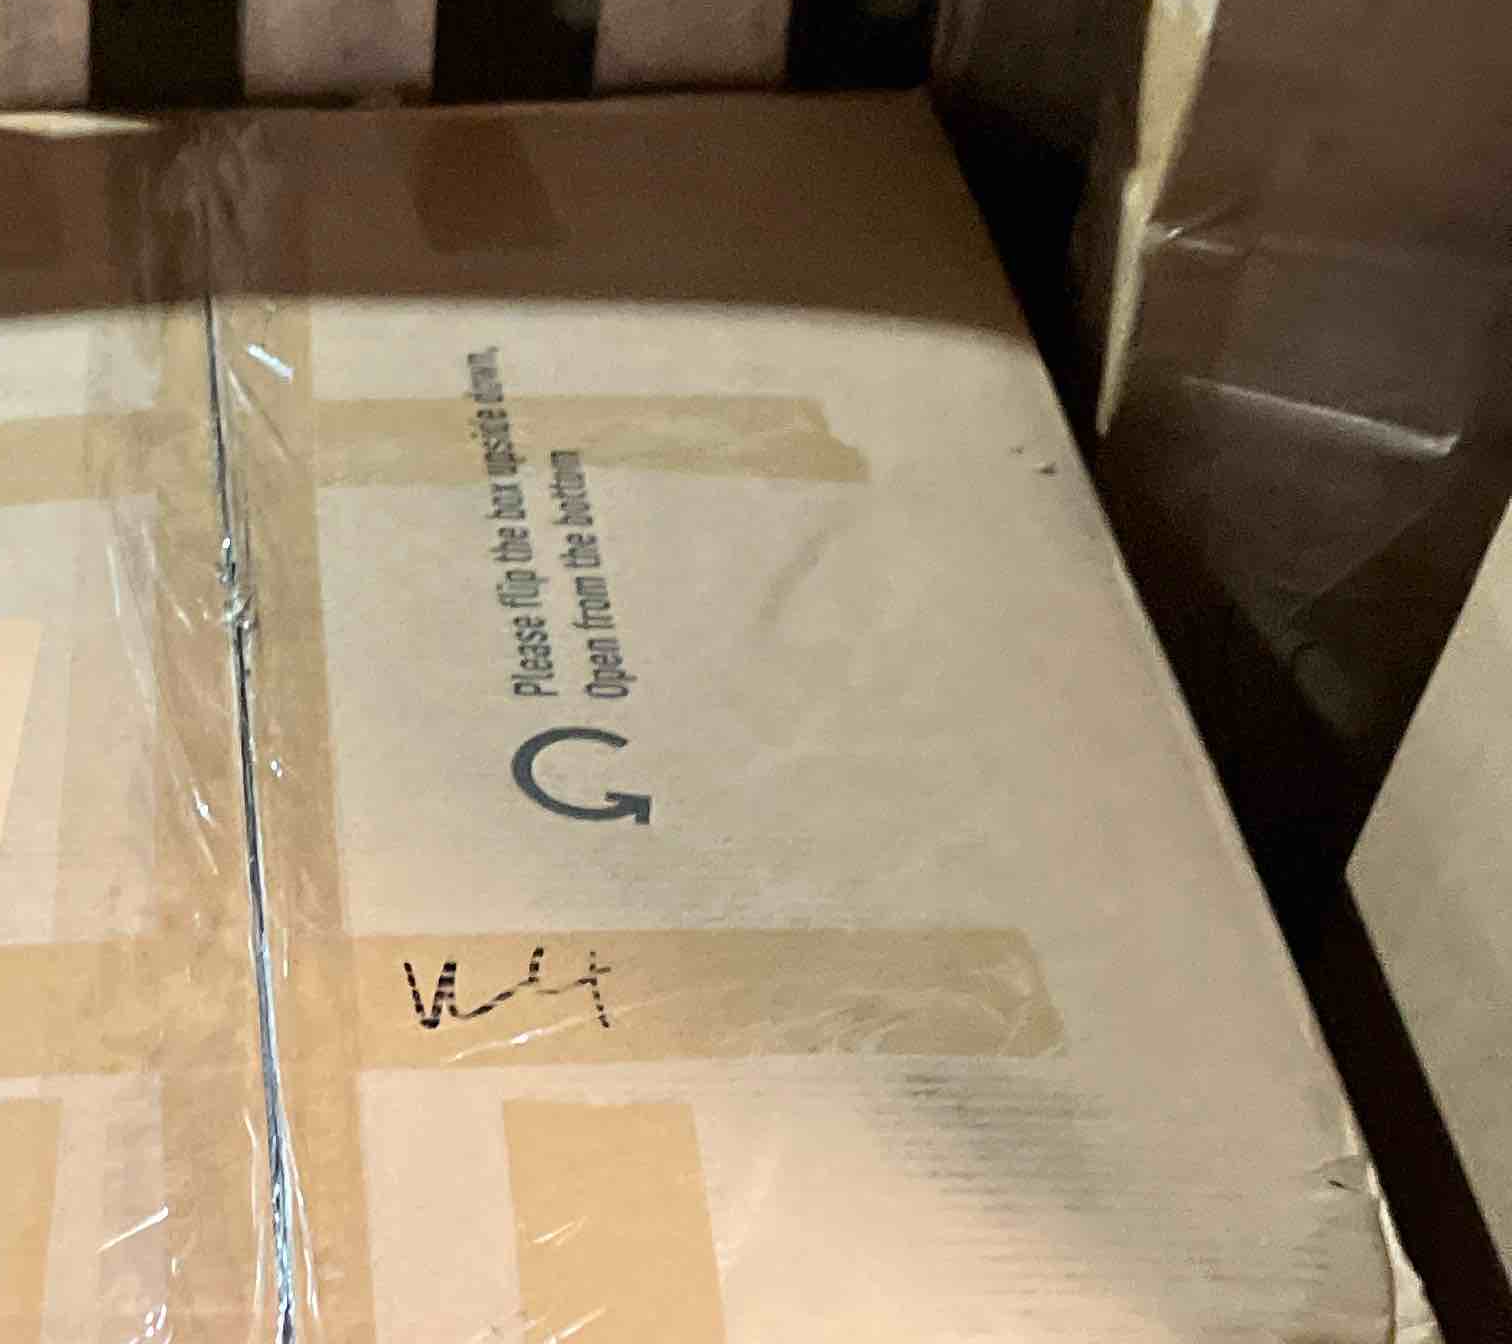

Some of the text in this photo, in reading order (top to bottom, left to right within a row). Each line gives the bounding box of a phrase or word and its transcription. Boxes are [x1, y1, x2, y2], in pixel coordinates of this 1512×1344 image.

[469, 409, 527, 475] upside
[485, 483, 526, 520] box
[490, 526, 533, 562] the
[496, 570, 550, 608] flip
[549, 451, 638, 699] Open from the bottom
[511, 615, 559, 697] Please
